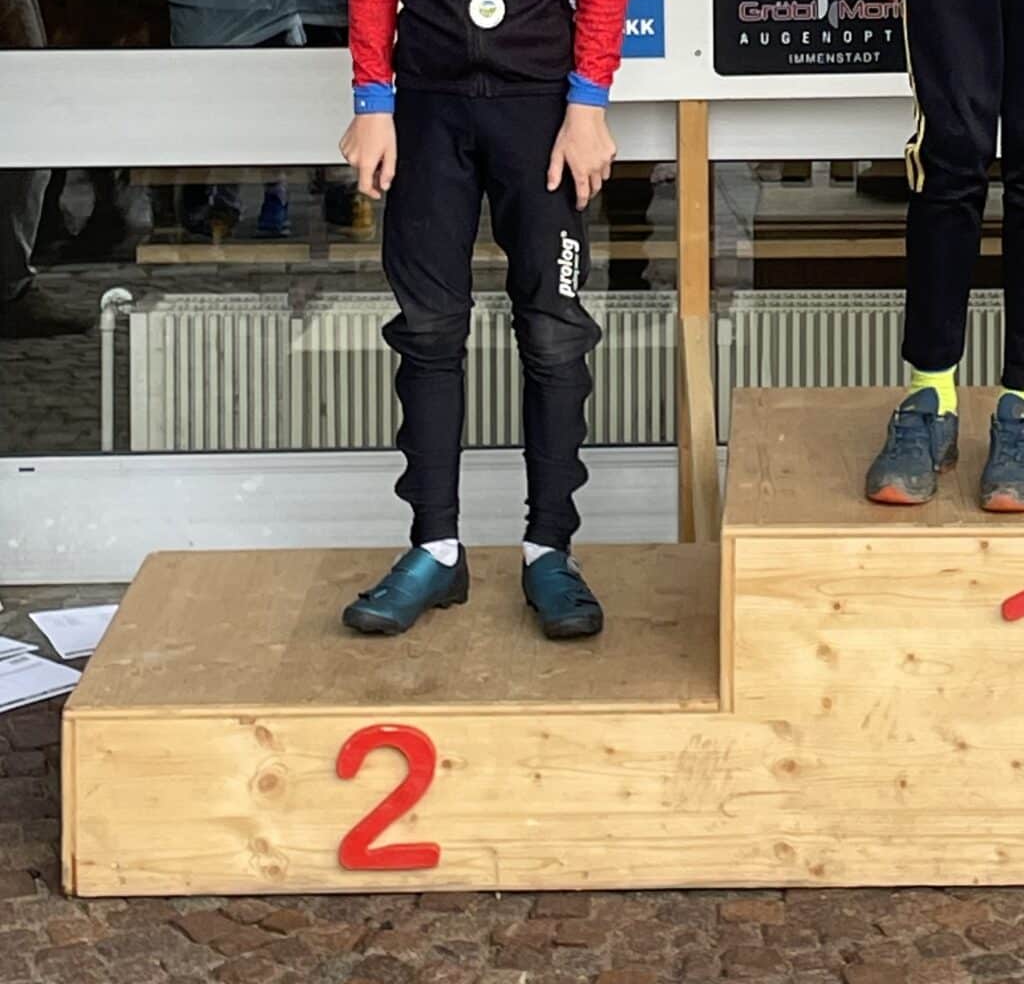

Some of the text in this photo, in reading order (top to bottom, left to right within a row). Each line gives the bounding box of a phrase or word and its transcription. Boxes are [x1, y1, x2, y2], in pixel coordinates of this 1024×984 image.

[622, 18, 655, 36] KK
[740, 29, 893, 45] AUGENOPT
[788, 51, 881, 64] IMMENSTADT
[336, 724, 442, 871] 2
